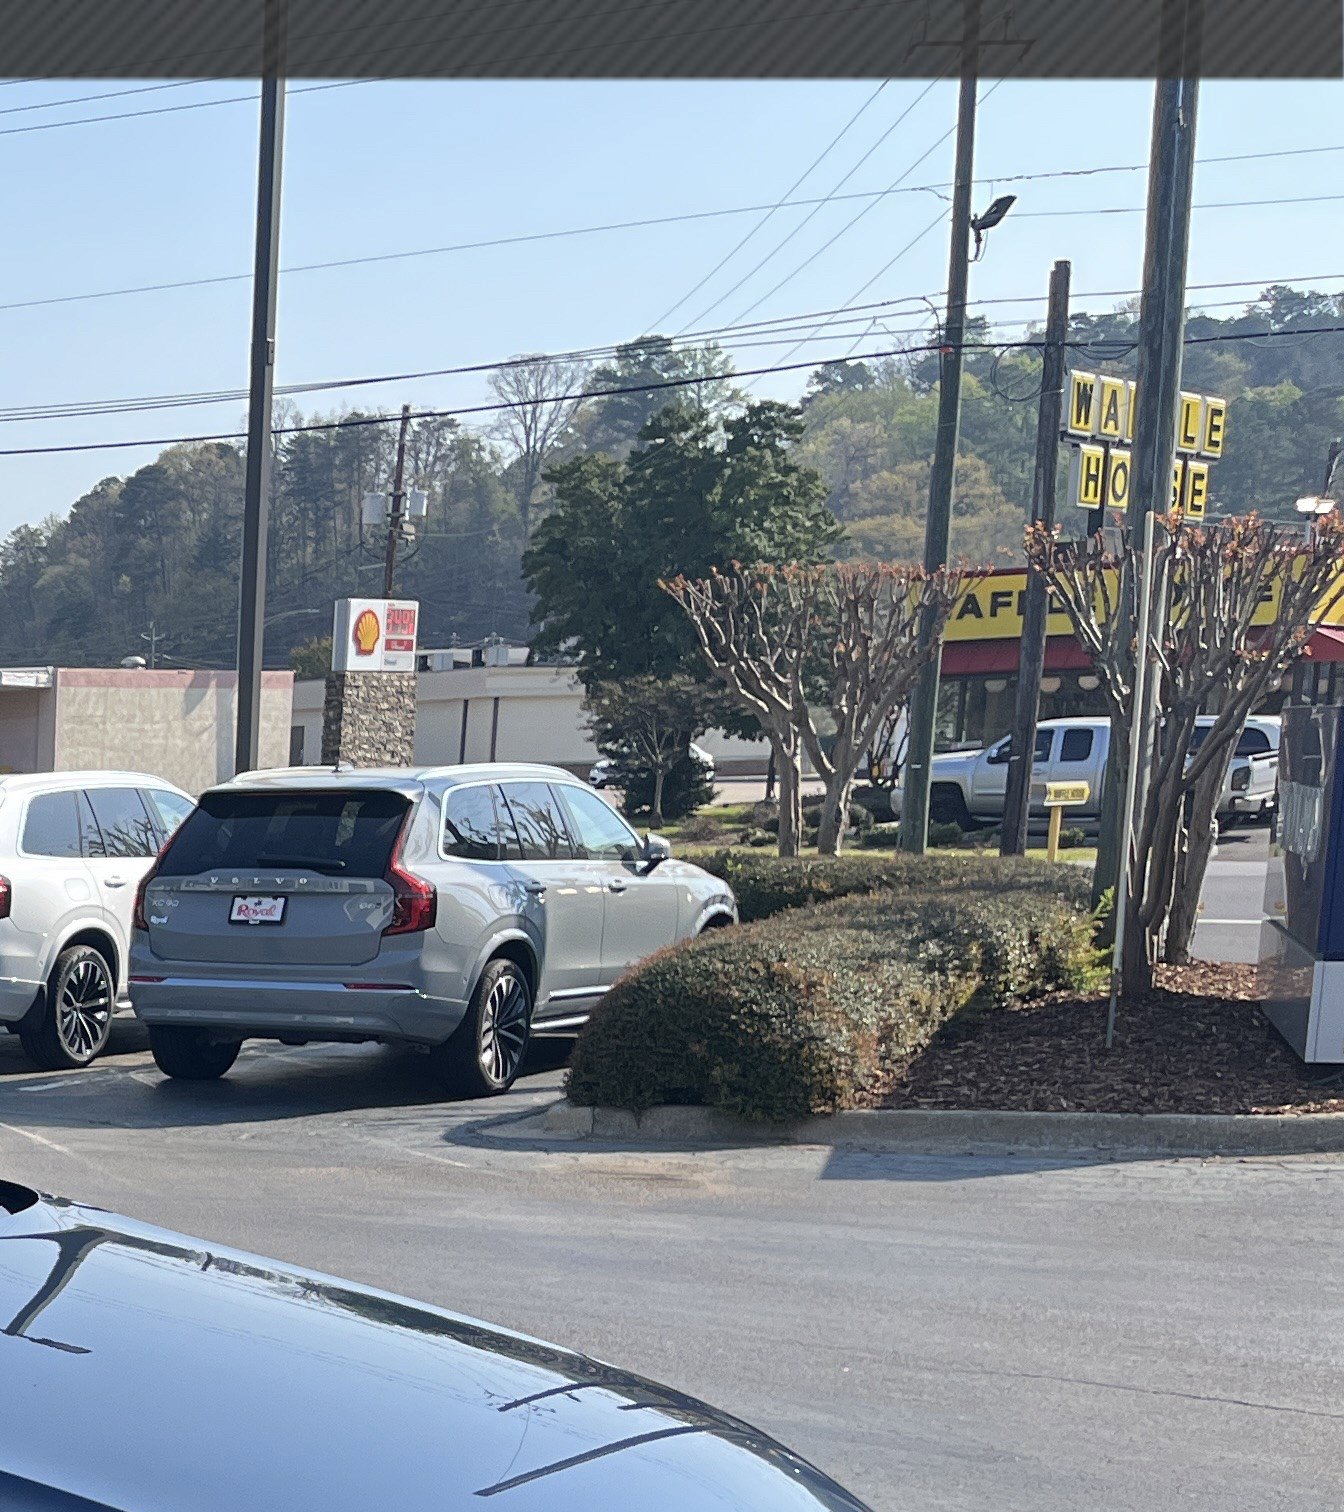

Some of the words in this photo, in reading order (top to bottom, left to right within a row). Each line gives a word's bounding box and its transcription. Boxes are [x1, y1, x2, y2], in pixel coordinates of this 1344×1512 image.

[1075, 381, 1223, 448] WALE
[1083, 456, 1205, 512] HOE
[210, 877, 308, 885] VOLVO
[237, 904, 277, 919] Royal
